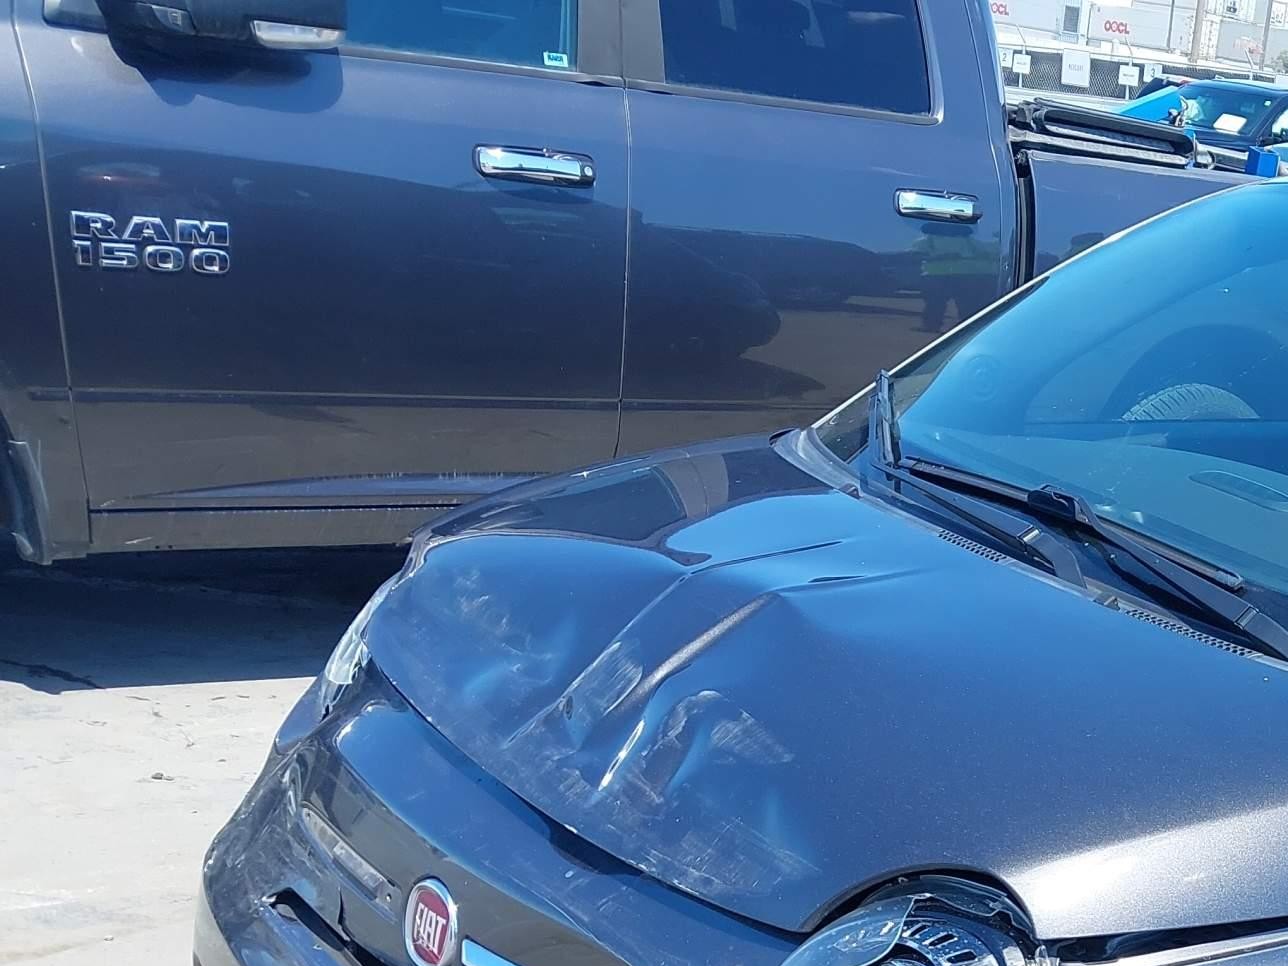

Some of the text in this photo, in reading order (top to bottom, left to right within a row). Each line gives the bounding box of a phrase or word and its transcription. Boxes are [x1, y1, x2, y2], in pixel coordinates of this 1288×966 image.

[990, 2, 1009, 16] OCL
[1104, 20, 1130, 35] OOCL
[70, 210, 231, 247] RAM
[72, 239, 231, 275] 1500
[413, 902, 447, 955] FIAT
